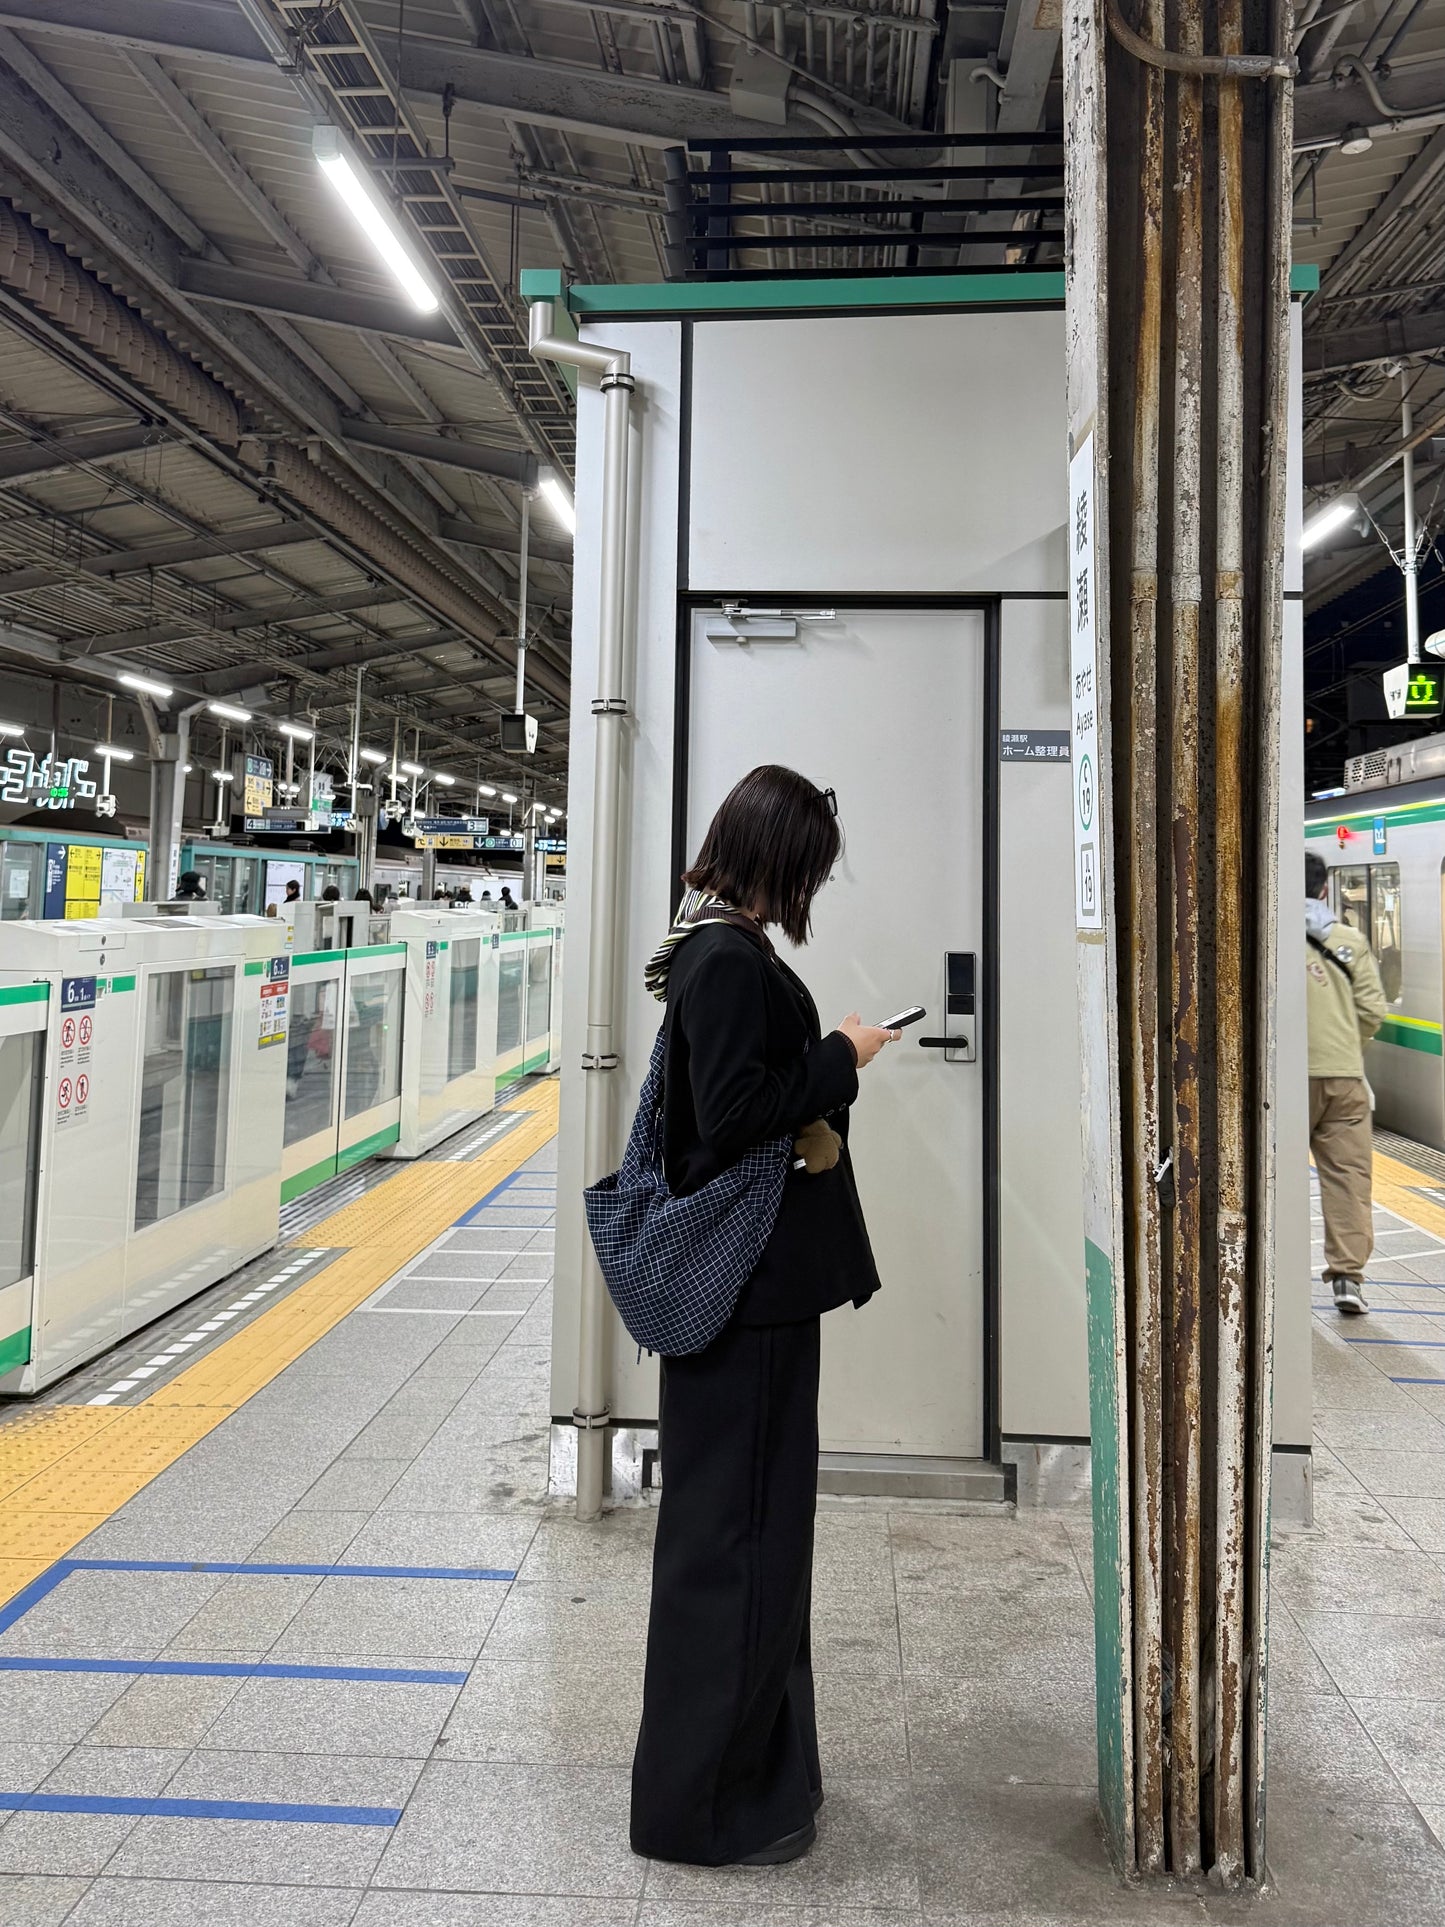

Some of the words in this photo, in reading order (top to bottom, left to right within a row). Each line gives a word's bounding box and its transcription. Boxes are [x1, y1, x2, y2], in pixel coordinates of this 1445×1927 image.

[1076, 489, 1088, 634] 綾瀬
[1075, 664, 1092, 700] あやせ
[1076, 710, 1093, 740] Ayase
[1002, 745, 1070, 757] ホーム整理員
[1082, 787, 1091, 815] 19
[1084, 875, 1093, 902] 19
